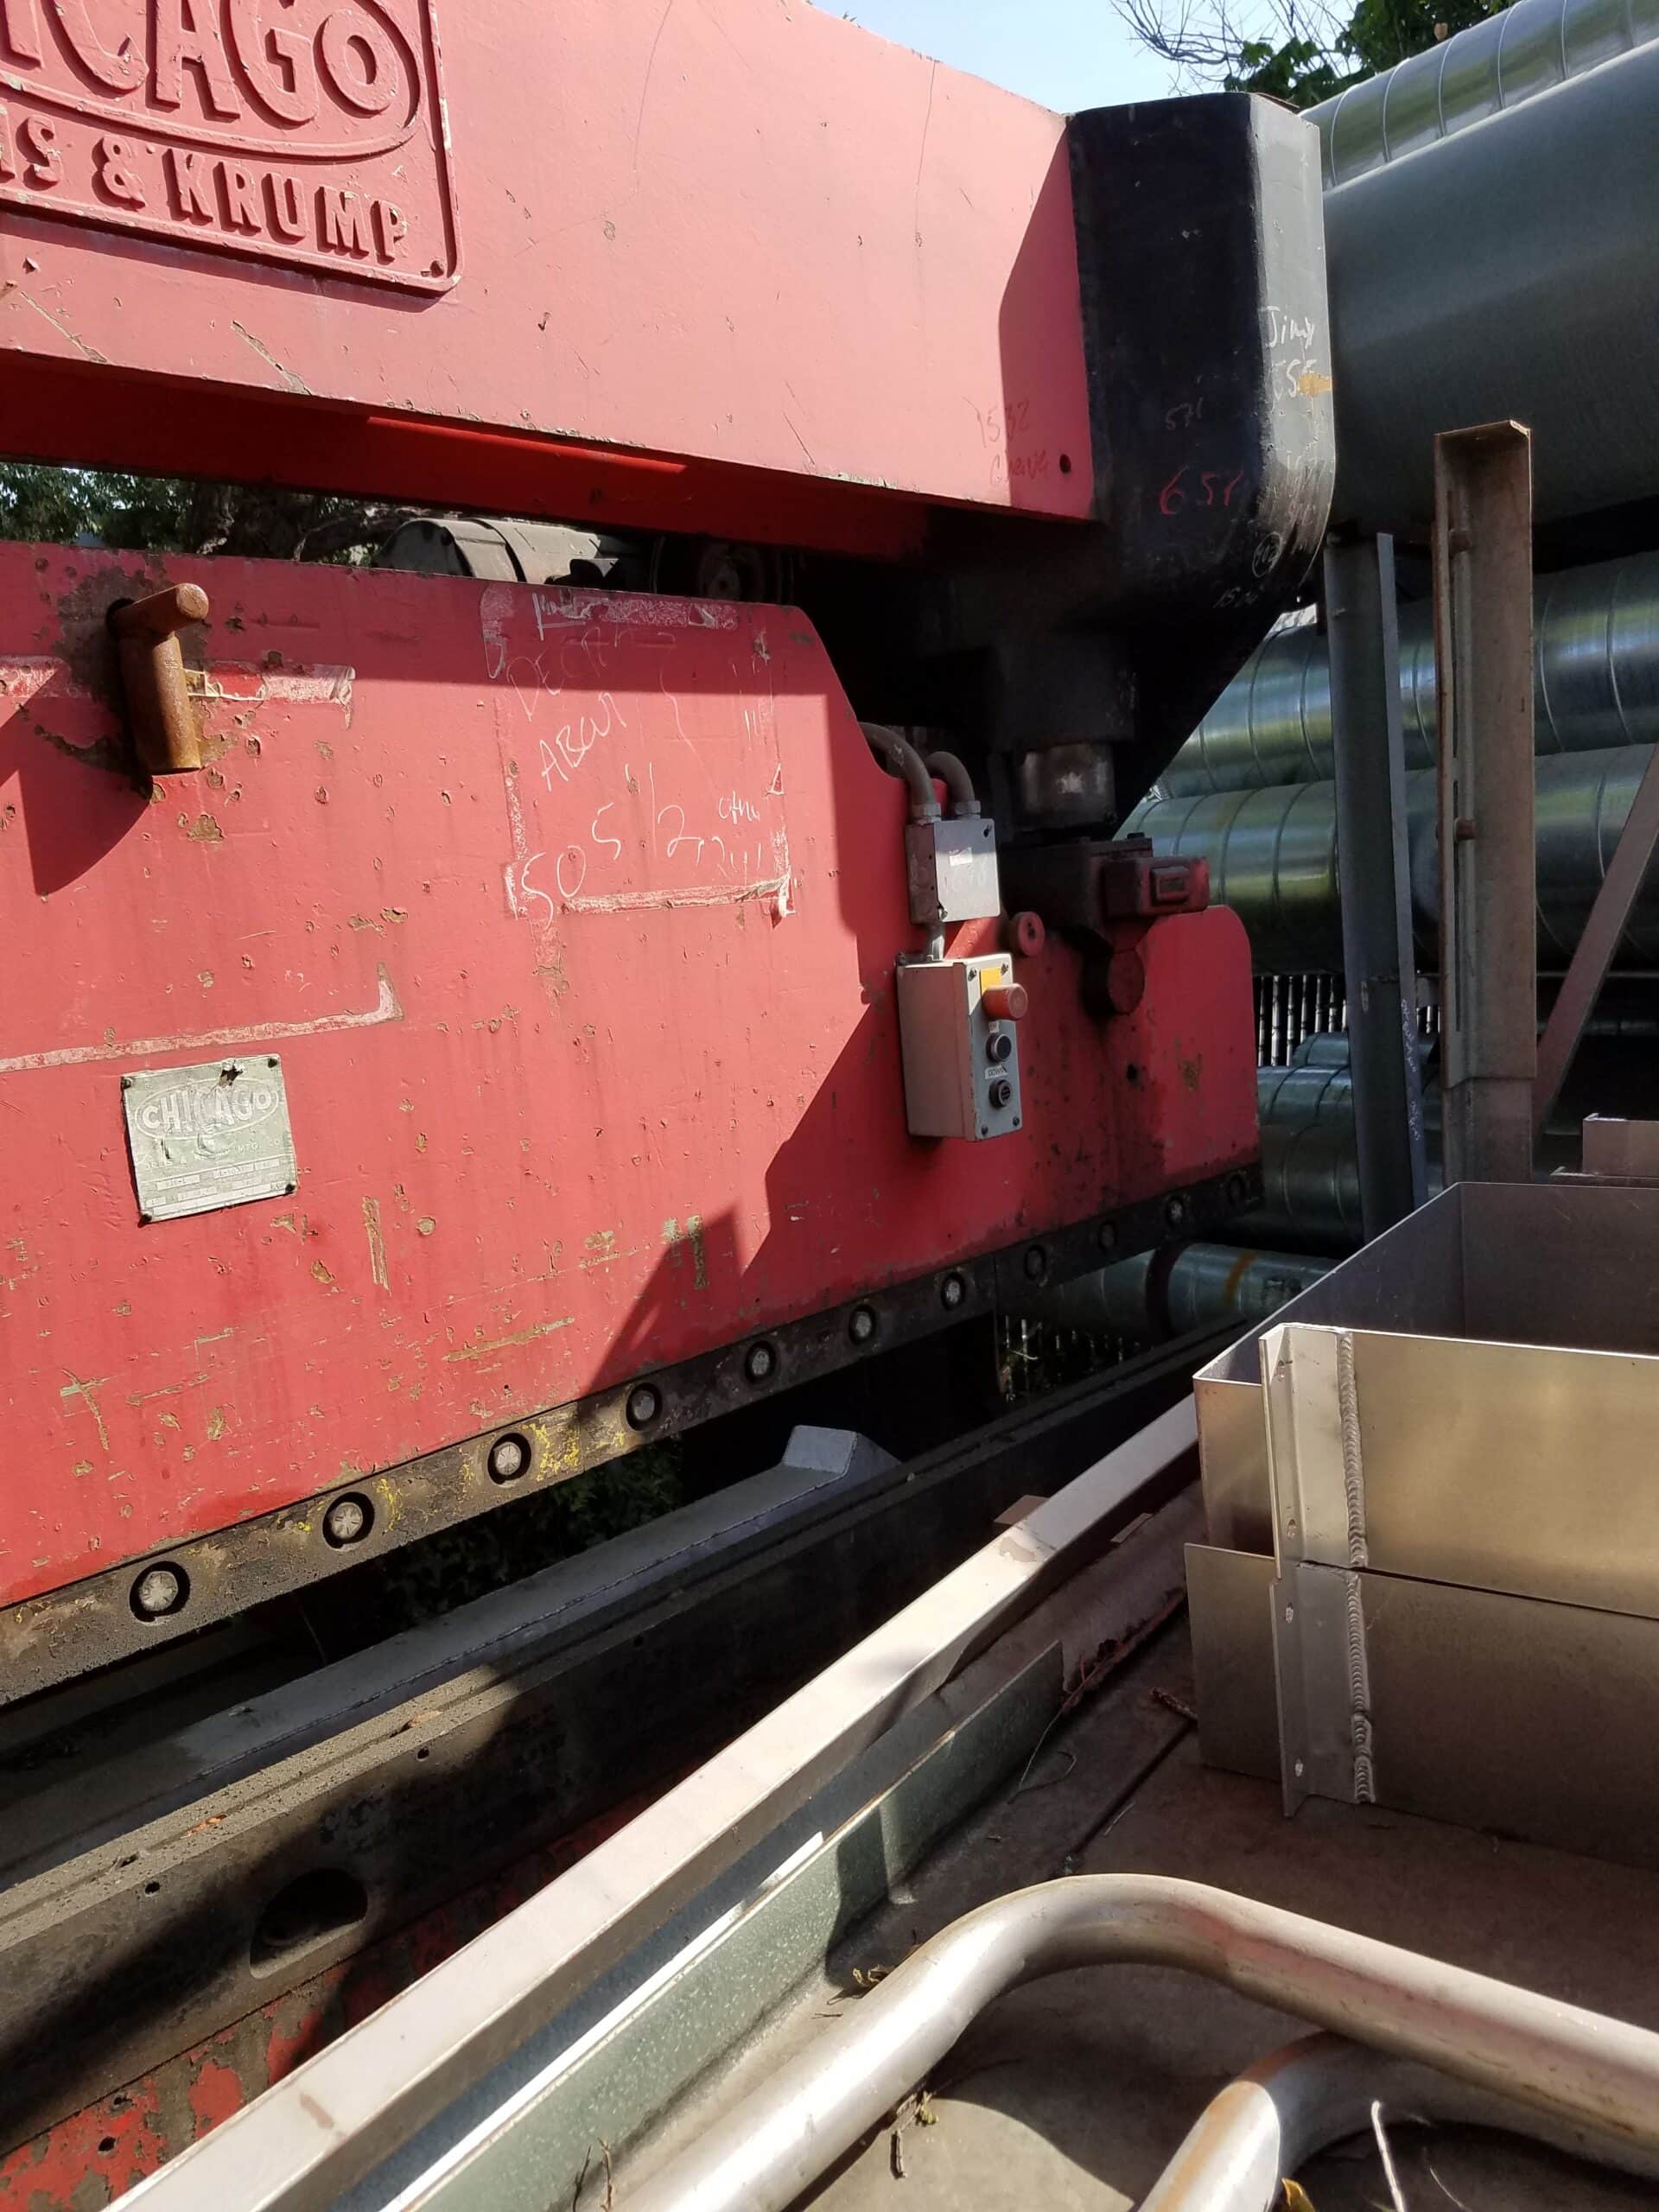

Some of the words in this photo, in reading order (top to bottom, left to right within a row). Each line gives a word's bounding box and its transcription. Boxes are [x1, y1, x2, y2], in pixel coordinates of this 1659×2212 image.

[92, 134, 148, 213] &
[162, 147, 408, 264] KRUMP
[142, 1085, 273, 1135] CHICAGO
